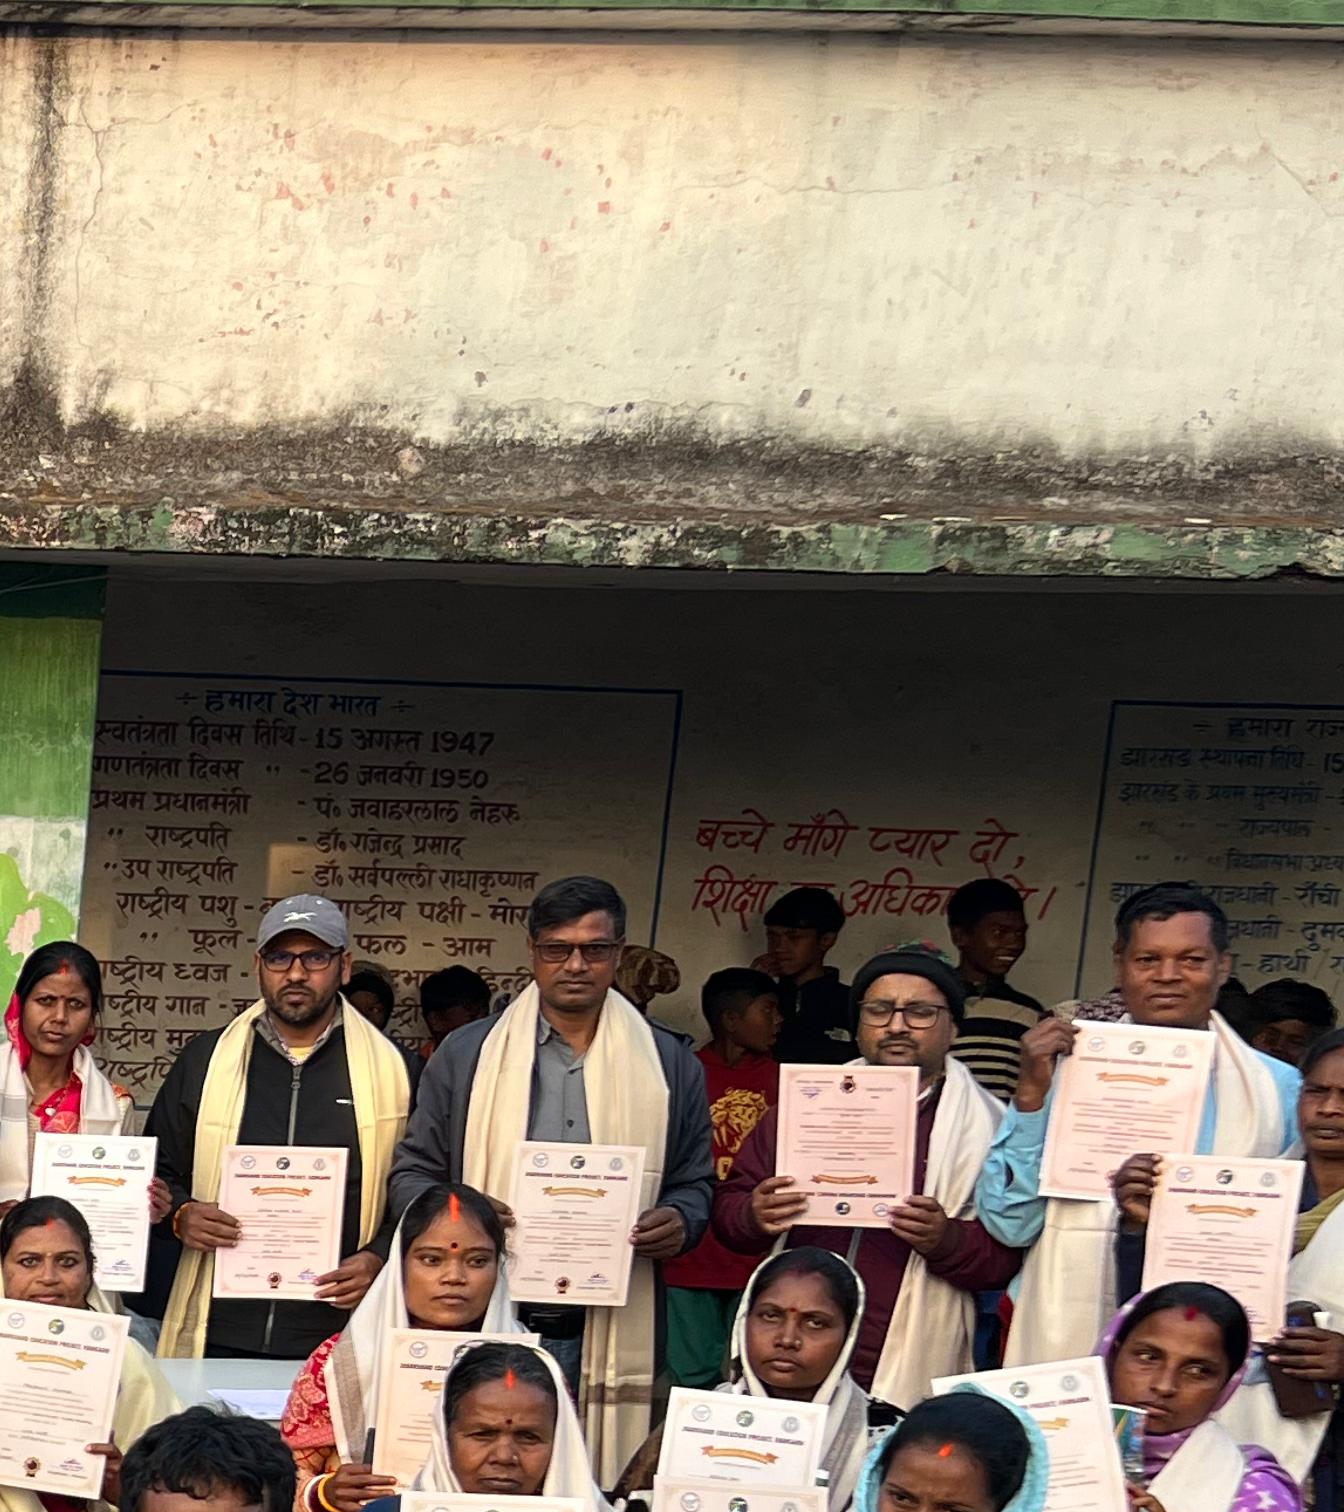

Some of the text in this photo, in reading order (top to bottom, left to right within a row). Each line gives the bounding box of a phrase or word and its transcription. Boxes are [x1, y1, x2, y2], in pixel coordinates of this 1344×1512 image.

[205, 687, 382, 717] हमारा देश भारत
[188, 716, 243, 747] दिवस
[315, 727, 494, 756] 15 अगस्त 1947
[188, 753, 244, 780] दिवस
[314, 761, 488, 789] 26 जनवरी 1950
[92, 786, 252, 816] प्रथम प्रधानमंत्री
[349, 799, 460, 824] जवाहरलाल
[144, 822, 233, 853] राष्ट्रपति
[412, 834, 467, 859] प्रसाद
[696, 809, 775, 853] बच्चे
[783, 809, 859, 858] माँगे
[868, 826, 960, 868] प्यार
[122, 856, 238, 888] उप राष्ट्रपति
[116, 886, 239, 928] राष्ट्रीय पशु
[417, 896, 467, 925] पक्षी
[691, 865, 778, 932] शिक्षा
[838, 867, 952, 918] अधिका
[189, 929, 243, 957] फूल
[353, 934, 407, 956] फल
[442, 936, 497, 958] आम
[174, 962, 231, 983] ध्वज
[165, 995, 210, 1016] गान
